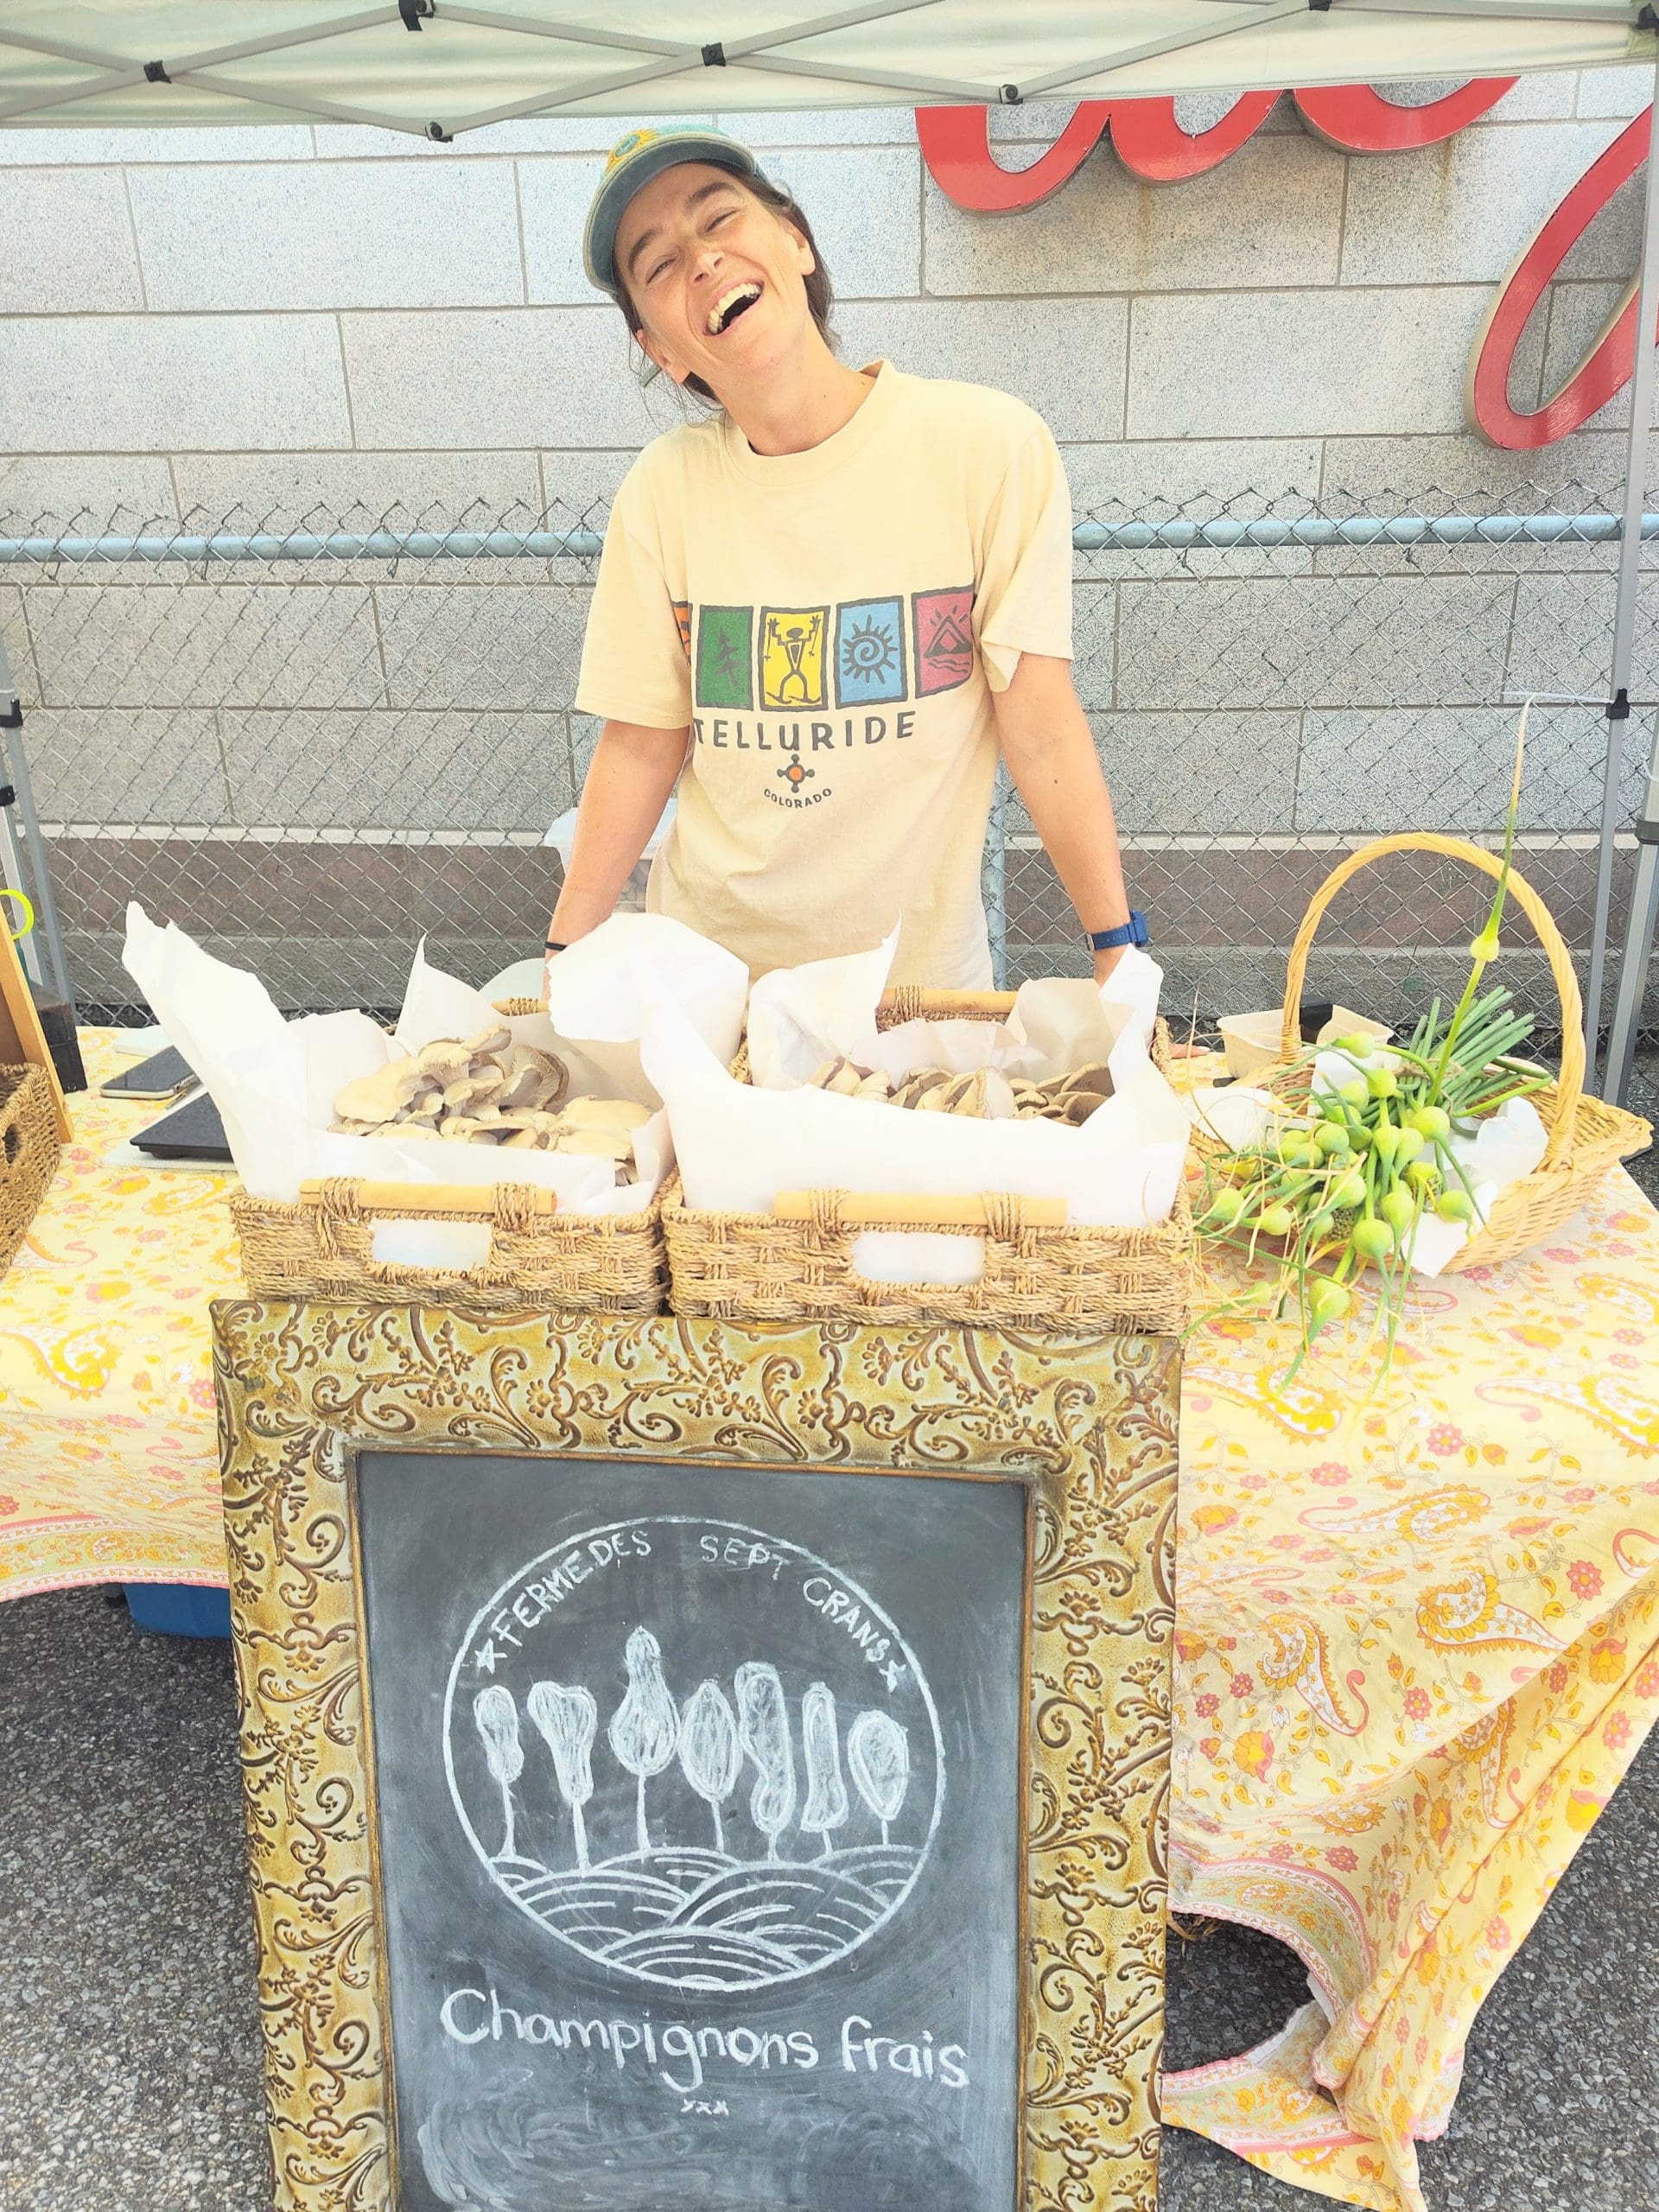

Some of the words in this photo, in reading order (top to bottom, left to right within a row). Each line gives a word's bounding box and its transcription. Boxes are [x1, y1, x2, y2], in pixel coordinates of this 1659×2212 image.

[693, 710, 916, 751] TELLURIDE
[763, 787, 832, 809] COLORADO
[491, 1549, 594, 1647] FERME
[588, 1530, 652, 1567] DES
[700, 1534, 791, 1580] SEPT
[803, 1577, 891, 1663] CRANS
[440, 1988, 819, 2093] Champignons
[841, 2015, 970, 2088] frais
